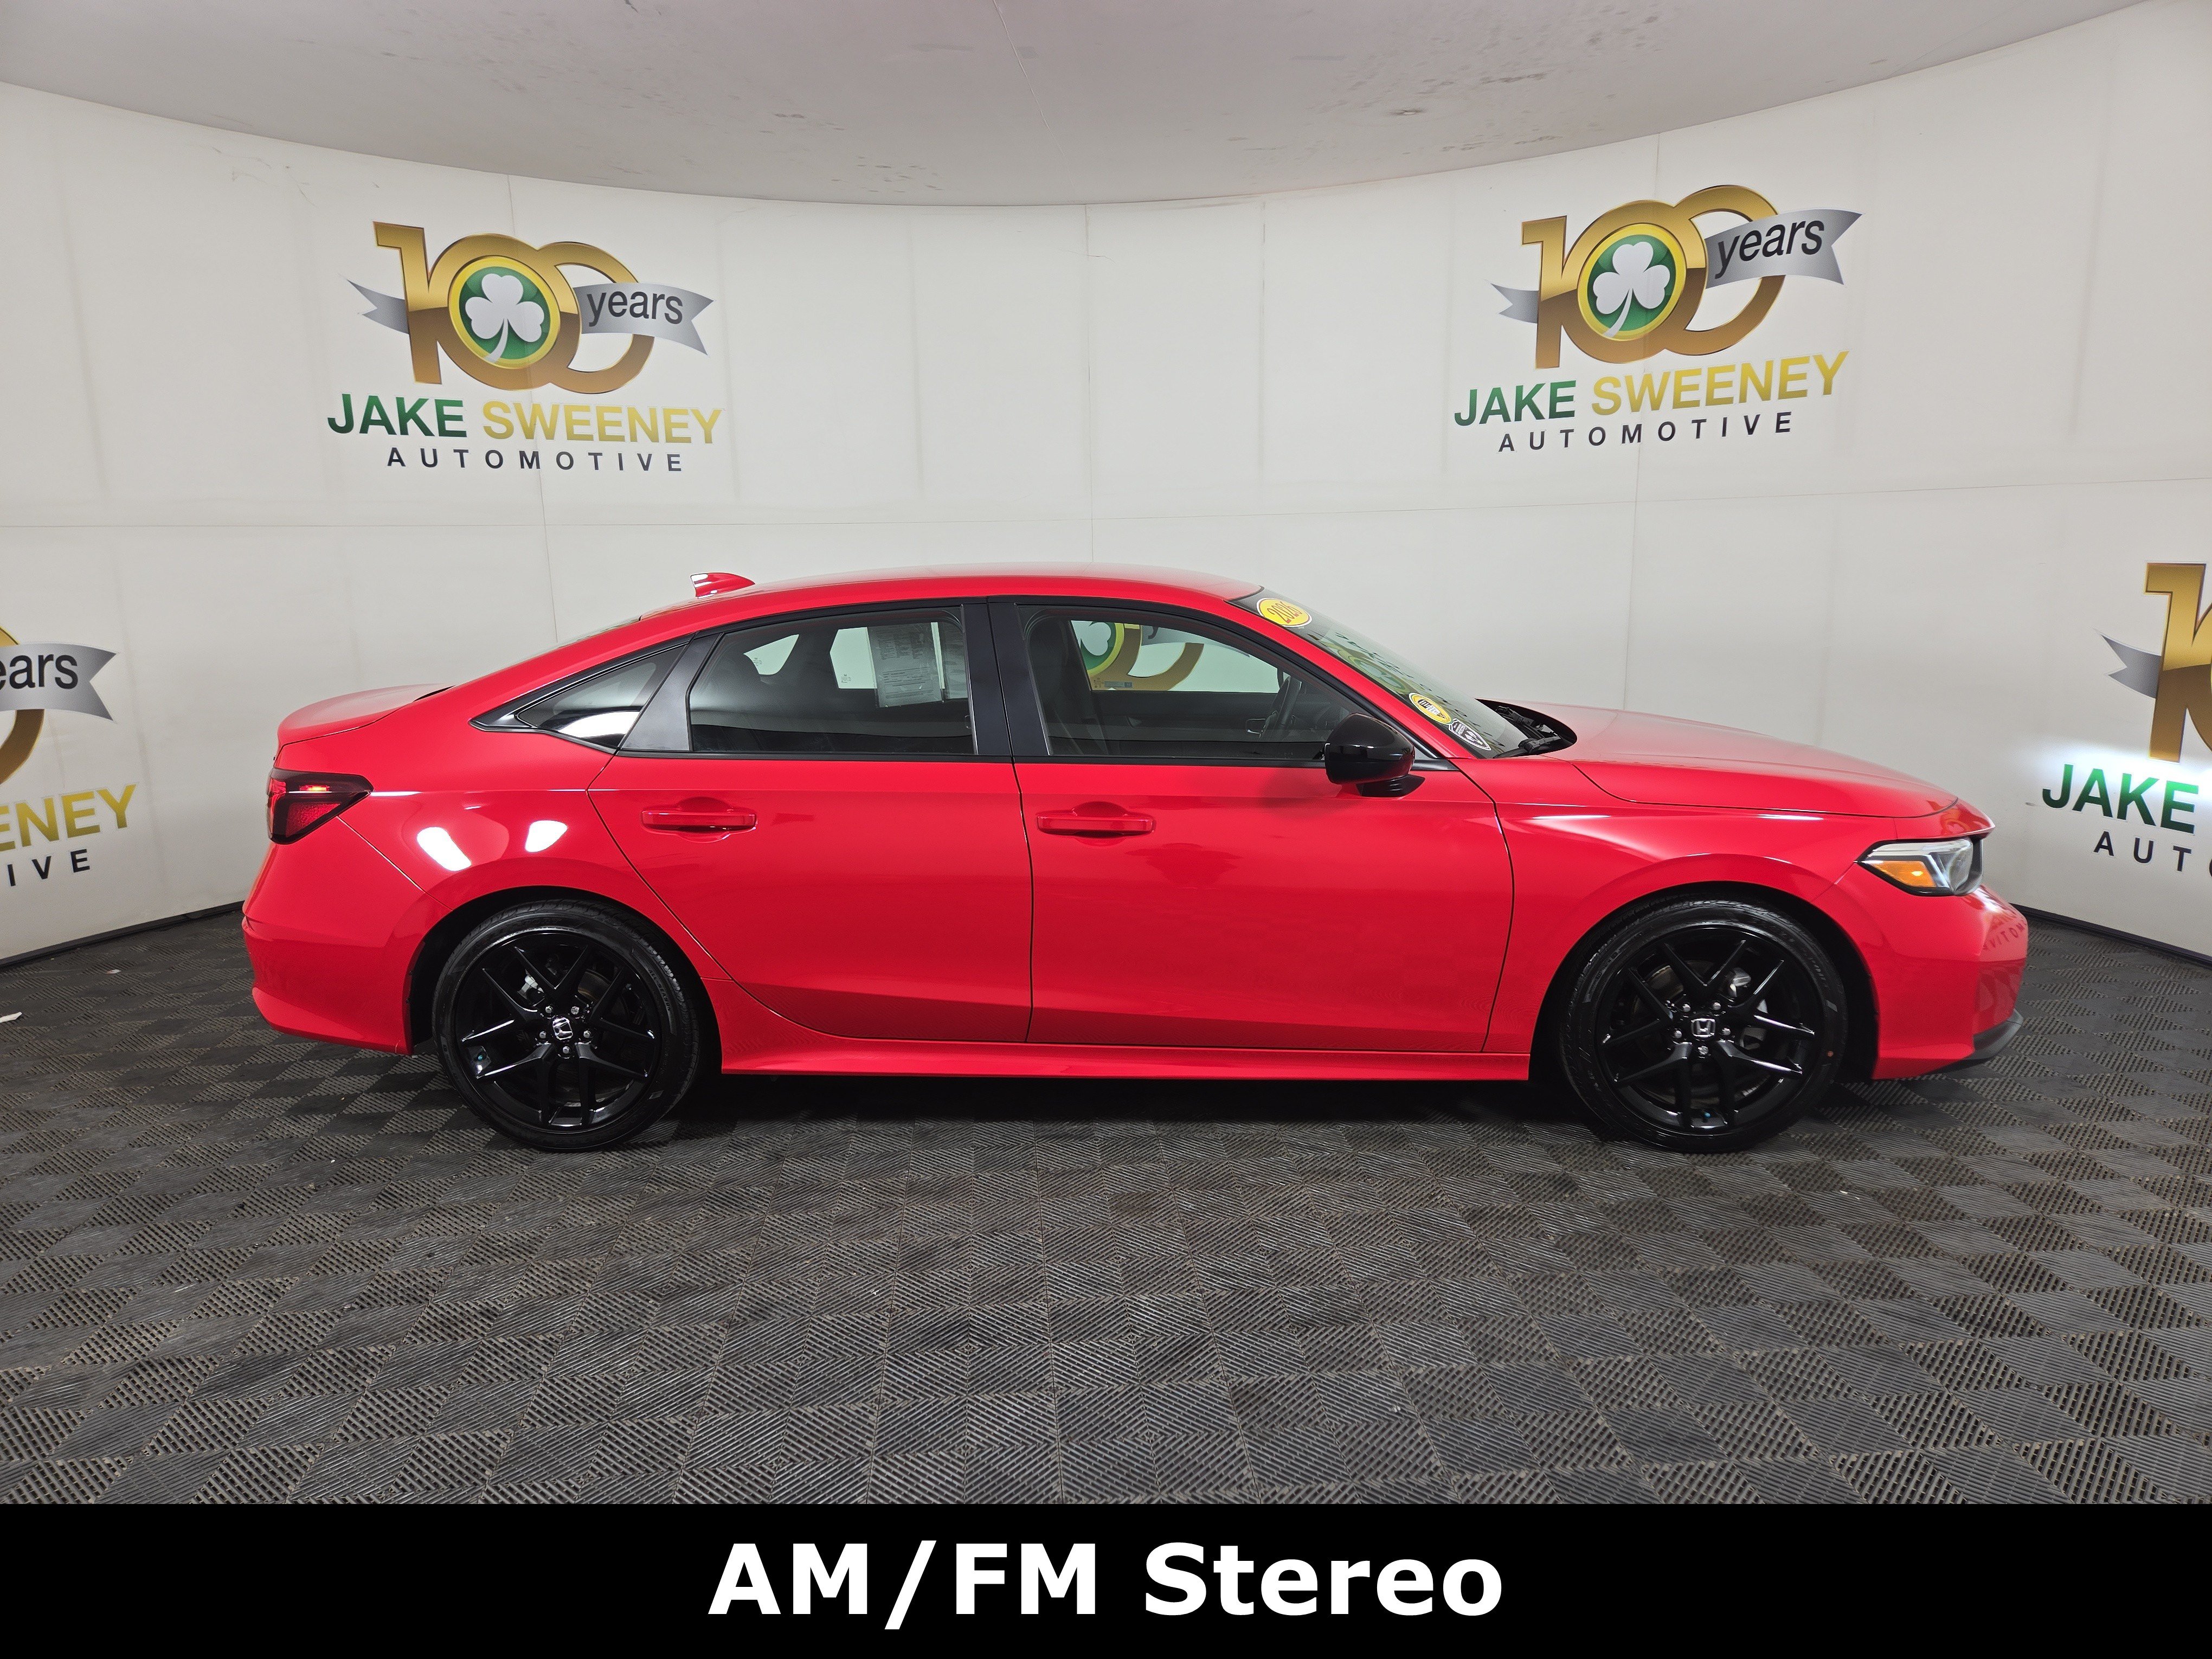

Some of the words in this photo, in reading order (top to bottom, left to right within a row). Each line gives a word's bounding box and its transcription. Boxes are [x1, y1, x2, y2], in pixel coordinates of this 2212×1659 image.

[1715, 219, 1825, 279] years
[587, 290, 684, 326] years
[1455, 380, 1577, 427] JAKE
[1592, 350, 1849, 416] SWEENEY
[327, 393, 467, 438] JAKE
[483, 401, 722, 445] SWEENEY
[1499, 411, 1792, 453] AUTOMOTIVE
[387, 447, 682, 472] AUTOMOTIVE
[1266, 601, 1303, 624] 2026
[2042, 764, 2199, 834] JAKE
[2093, 831, 2212, 878] AUT
